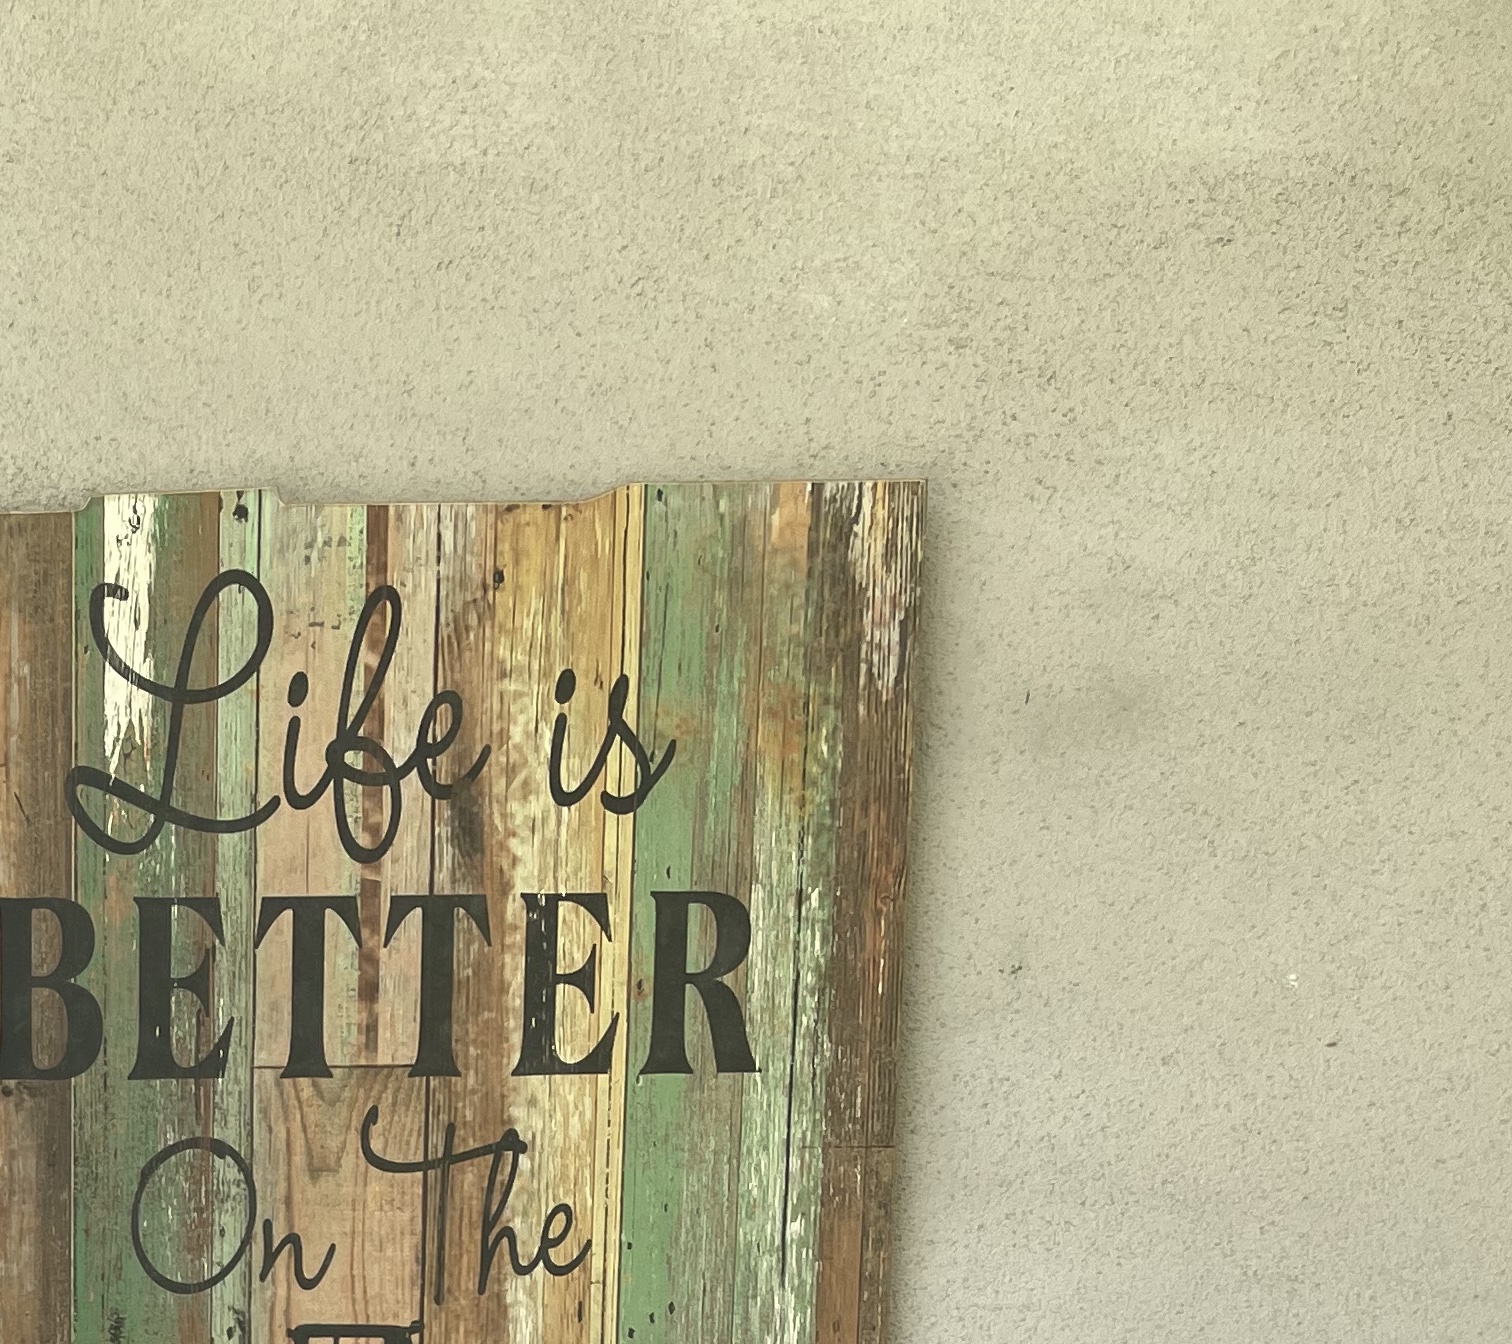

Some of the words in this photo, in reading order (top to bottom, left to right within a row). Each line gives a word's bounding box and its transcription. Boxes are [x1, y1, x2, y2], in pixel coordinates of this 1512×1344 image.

[65, 570, 491, 864] Life
[550, 668, 678, 814] is
[131, 1138, 336, 1296] On
[361, 1104, 592, 1305] The
